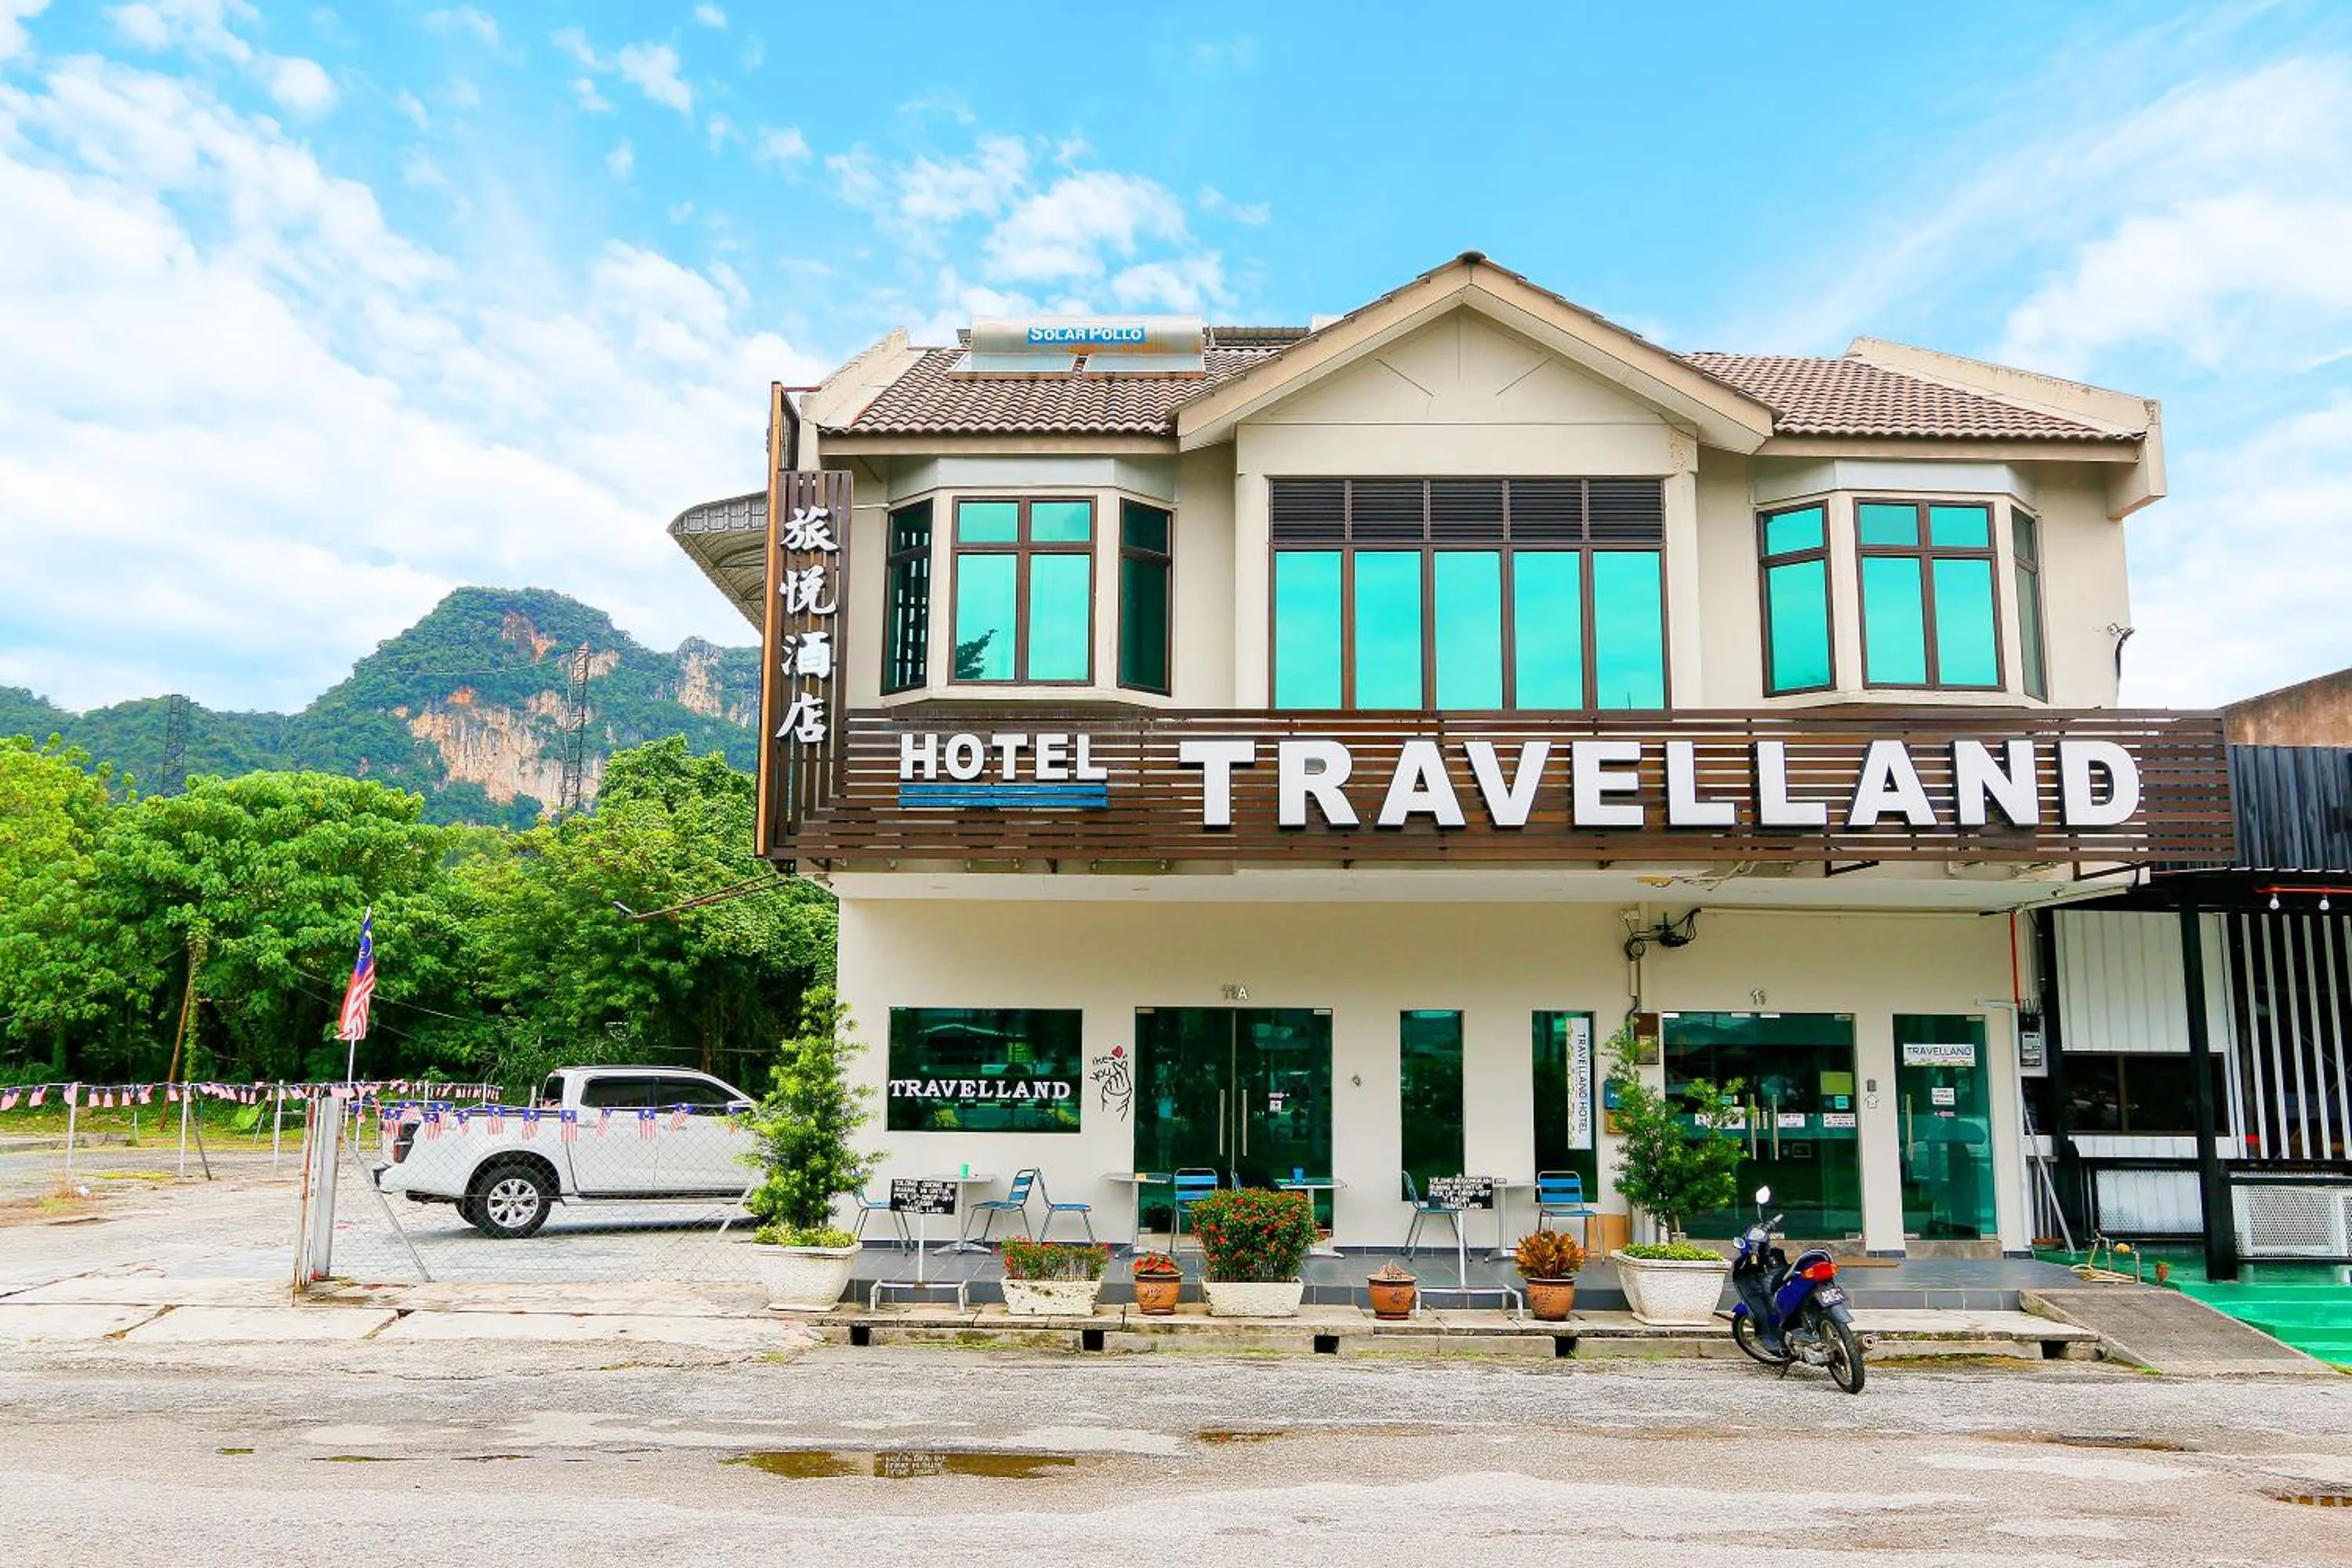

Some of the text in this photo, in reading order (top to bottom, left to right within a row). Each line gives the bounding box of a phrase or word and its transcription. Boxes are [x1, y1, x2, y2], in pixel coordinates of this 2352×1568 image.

[1030, 325, 1142, 341] SOLAR POLLO
[899, 733, 2143, 828] HOTEL TRAVELLAND
[1906, 1046, 1973, 1056] TRAVELLAND
[1577, 1033, 1588, 1098] TRAVELLAND
[889, 1079, 1072, 1099] TRAVELLAND
[1578, 1102, 1588, 1134] HOTEL
